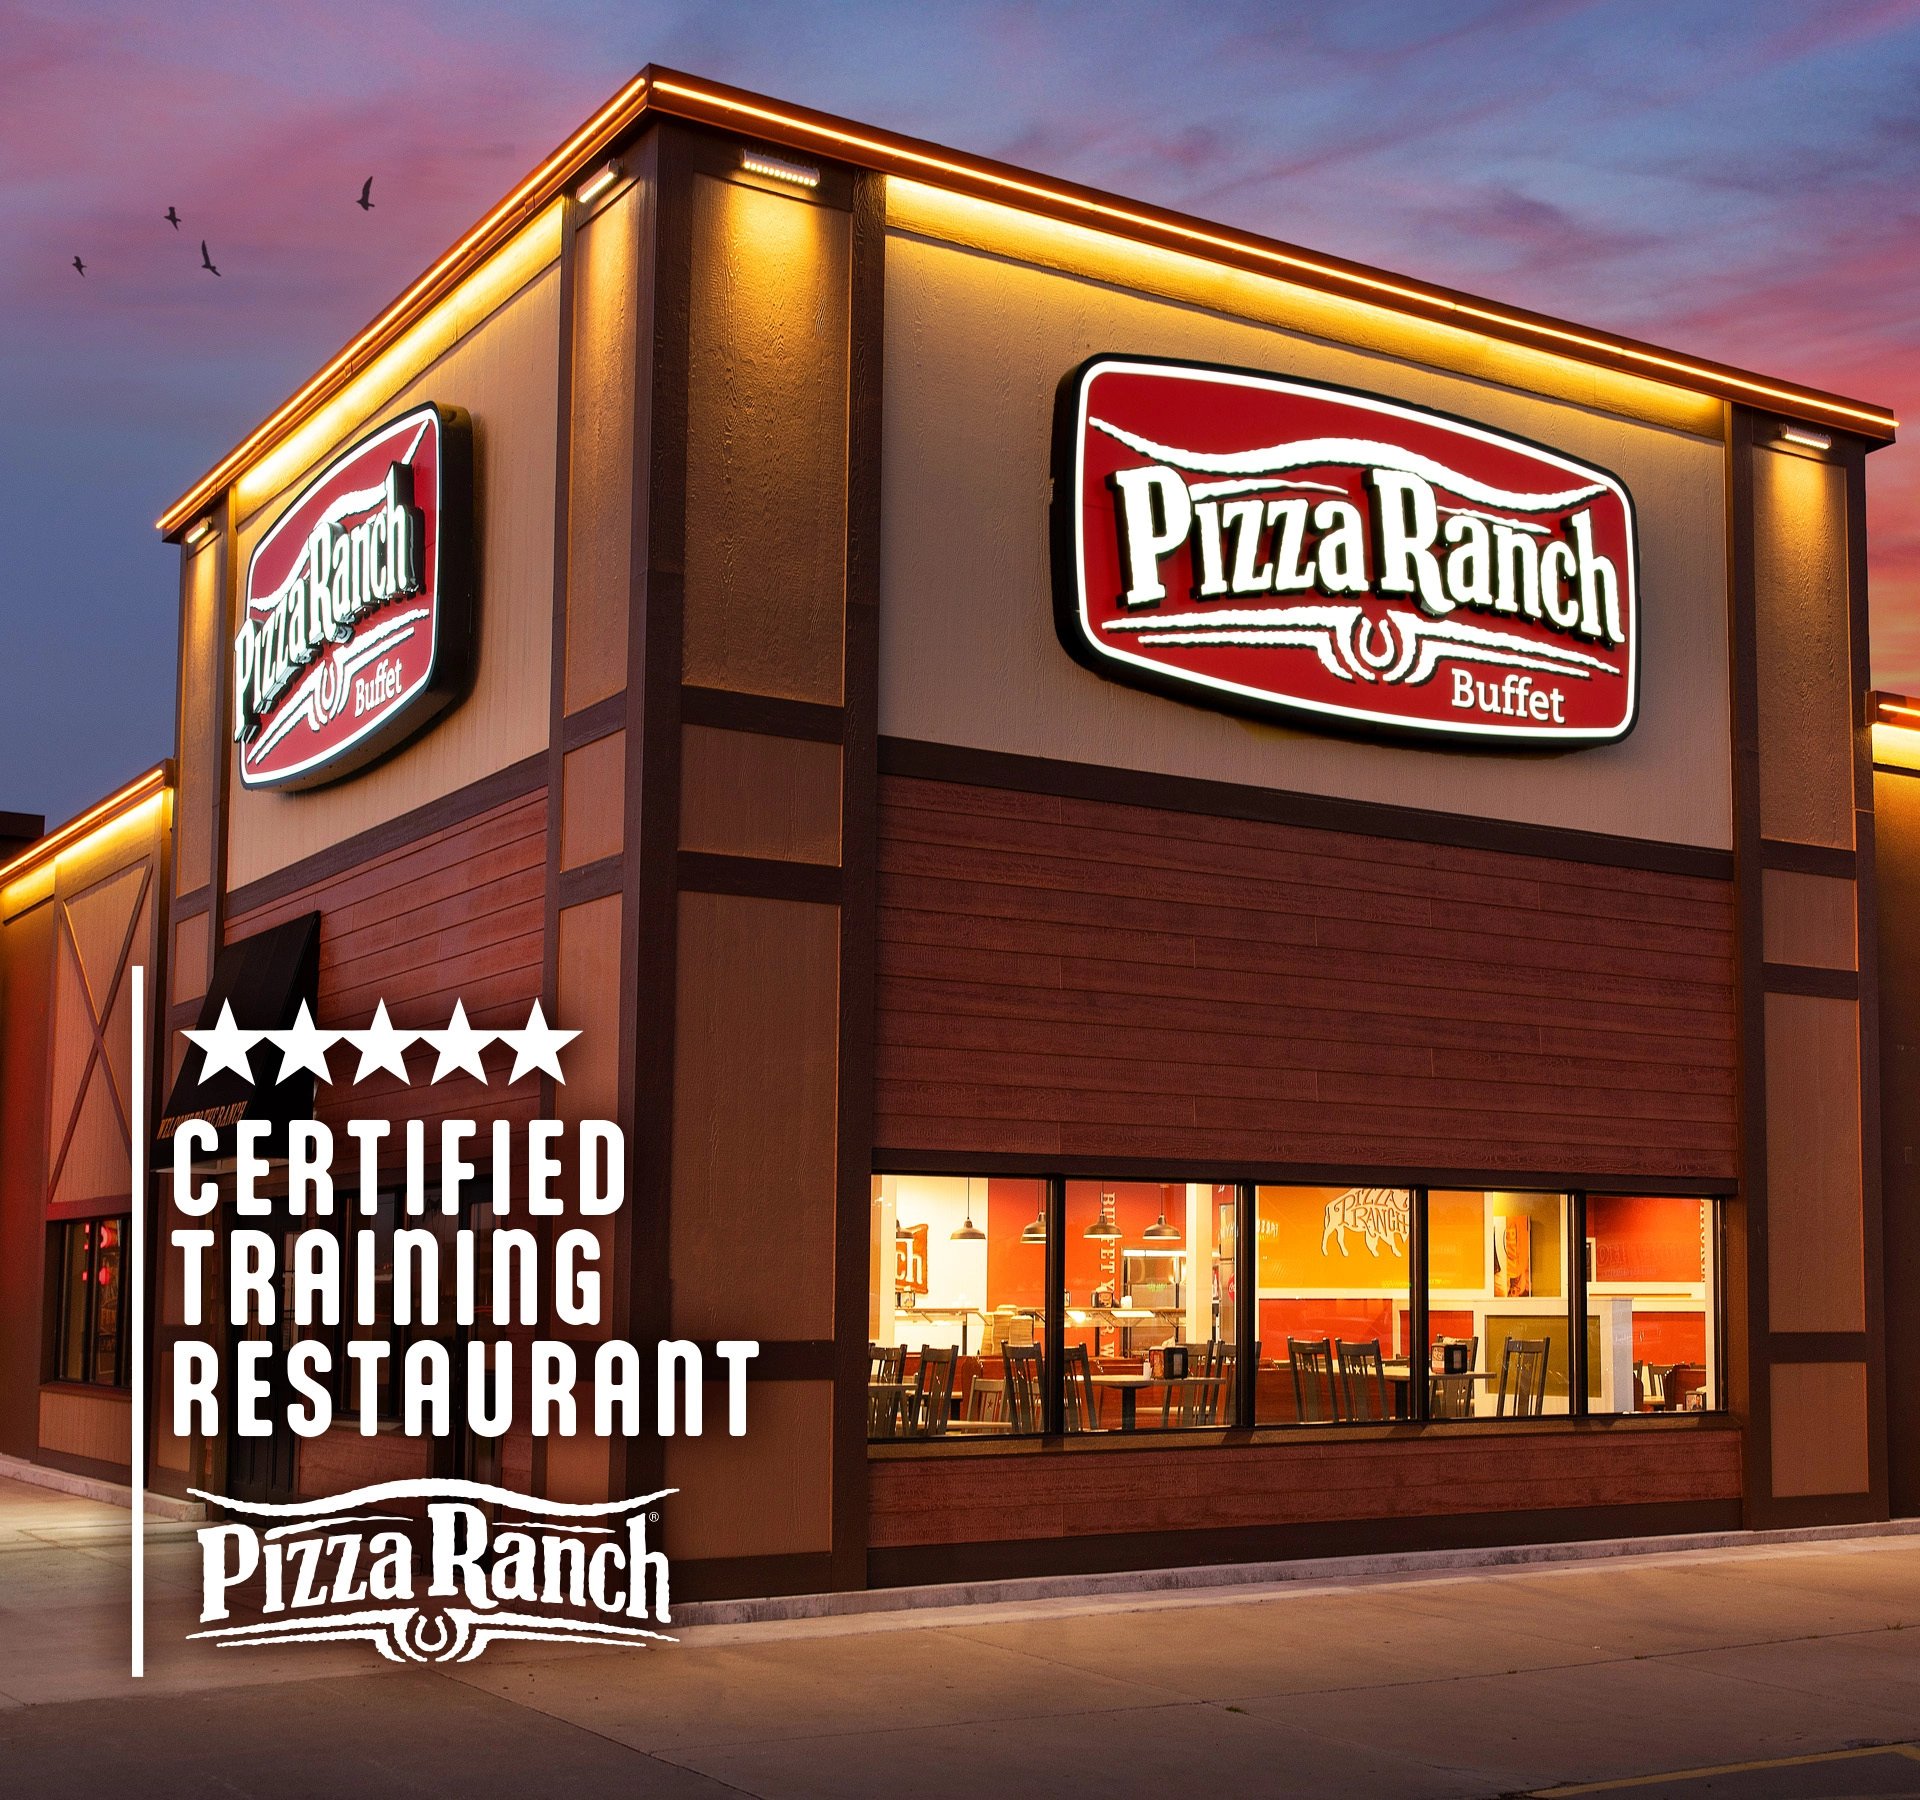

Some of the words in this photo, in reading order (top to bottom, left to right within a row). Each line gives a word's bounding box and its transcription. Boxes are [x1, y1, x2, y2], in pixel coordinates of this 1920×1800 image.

[1116, 465, 1369, 605] Pizza
[1372, 468, 1626, 643] Ranch
[234, 577, 307, 741] Pizza
[308, 462, 412, 643] Ranch
[354, 658, 402, 718] Buffet
[1451, 668, 1566, 724] Buffet
[1100, 1192, 1116, 1274] BUFET
[1351, 1207, 1409, 1239] RANCH
